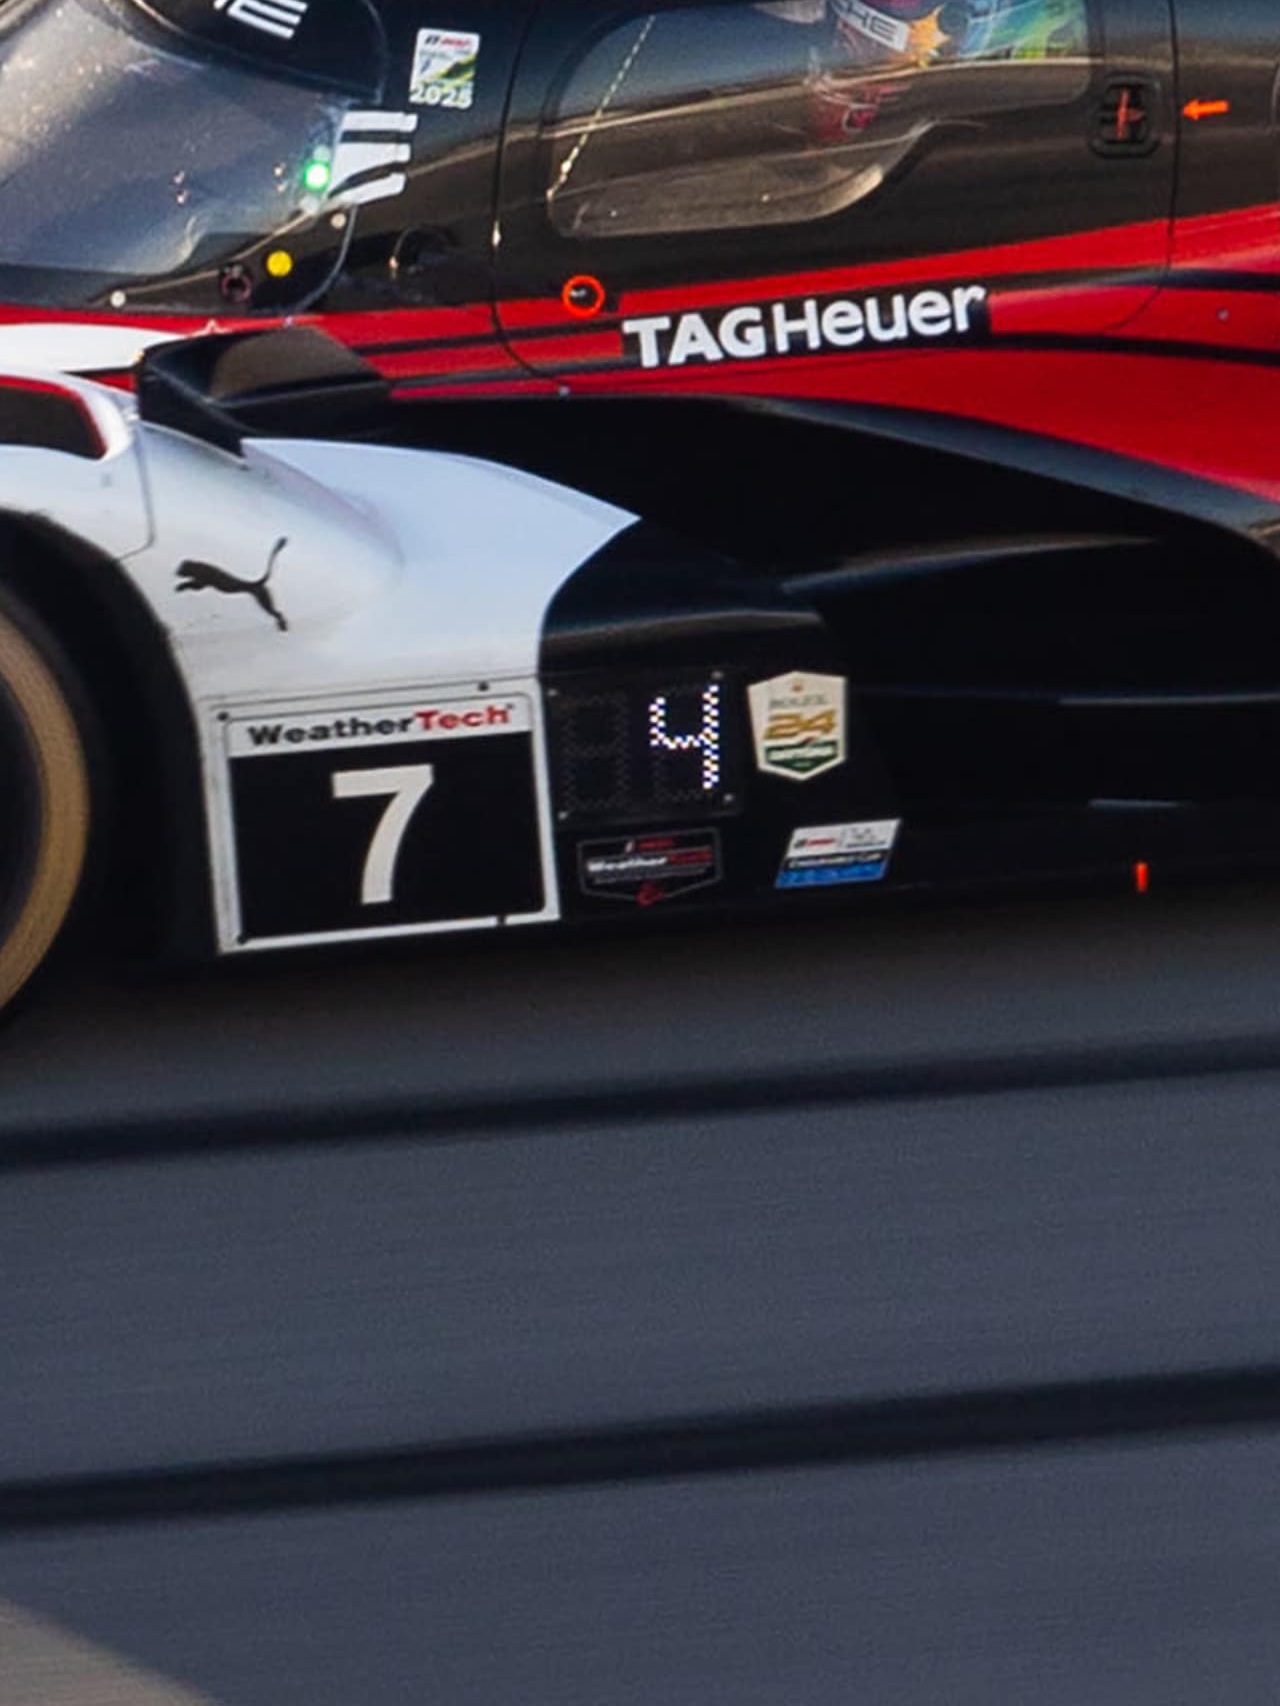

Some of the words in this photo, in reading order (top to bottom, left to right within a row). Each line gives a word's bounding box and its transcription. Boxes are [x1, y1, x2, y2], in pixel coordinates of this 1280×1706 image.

[248, 704, 511, 746] WeatherTech
[648, 684, 719, 789] 4
[331, 763, 433, 905] 7
